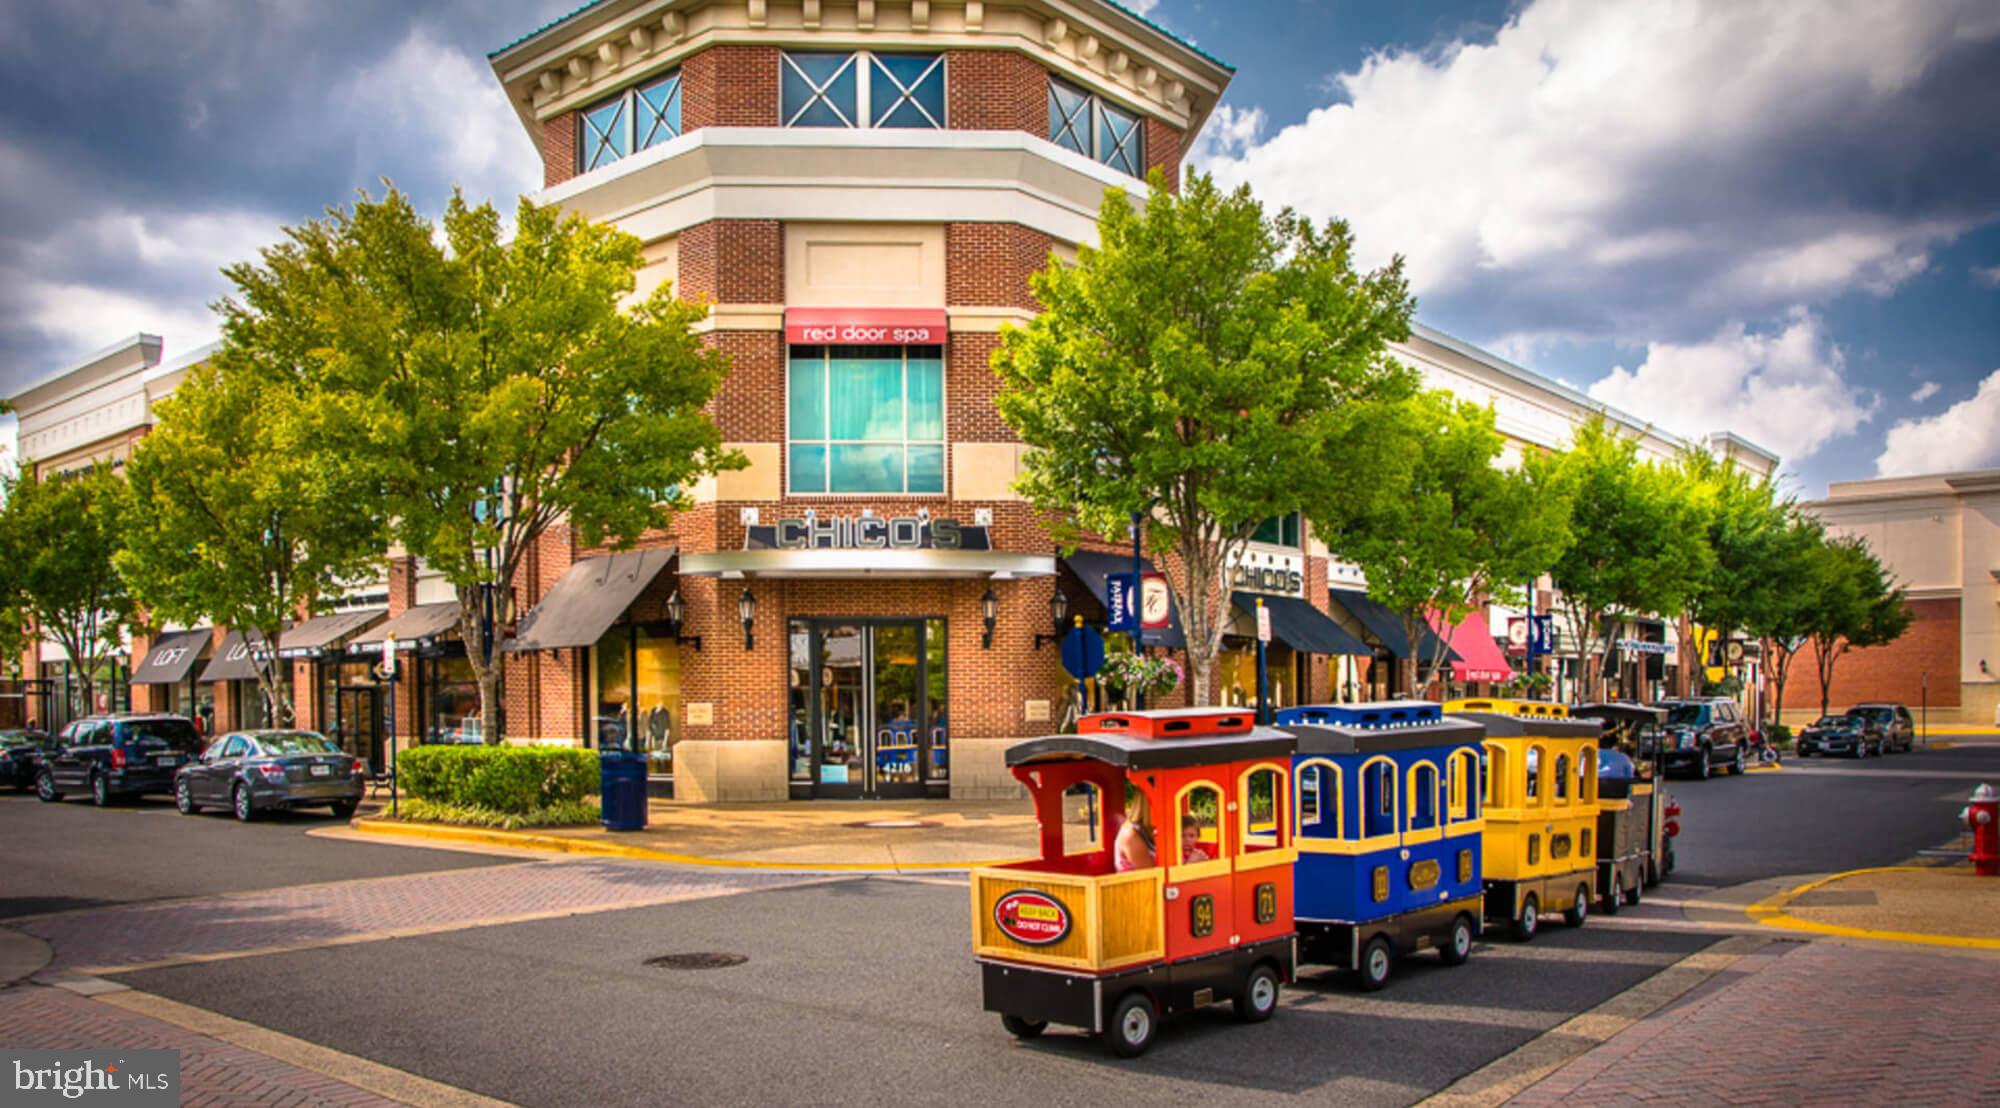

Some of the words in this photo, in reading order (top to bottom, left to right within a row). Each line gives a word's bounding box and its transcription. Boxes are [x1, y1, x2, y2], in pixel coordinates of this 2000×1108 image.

[802, 325, 836, 341] red
[841, 325, 888, 341] door
[893, 327, 930, 343] spa
[775, 515, 962, 549] CHICO'S
[151, 647, 190, 667] LOFT
[225, 639, 266, 662] LOT
